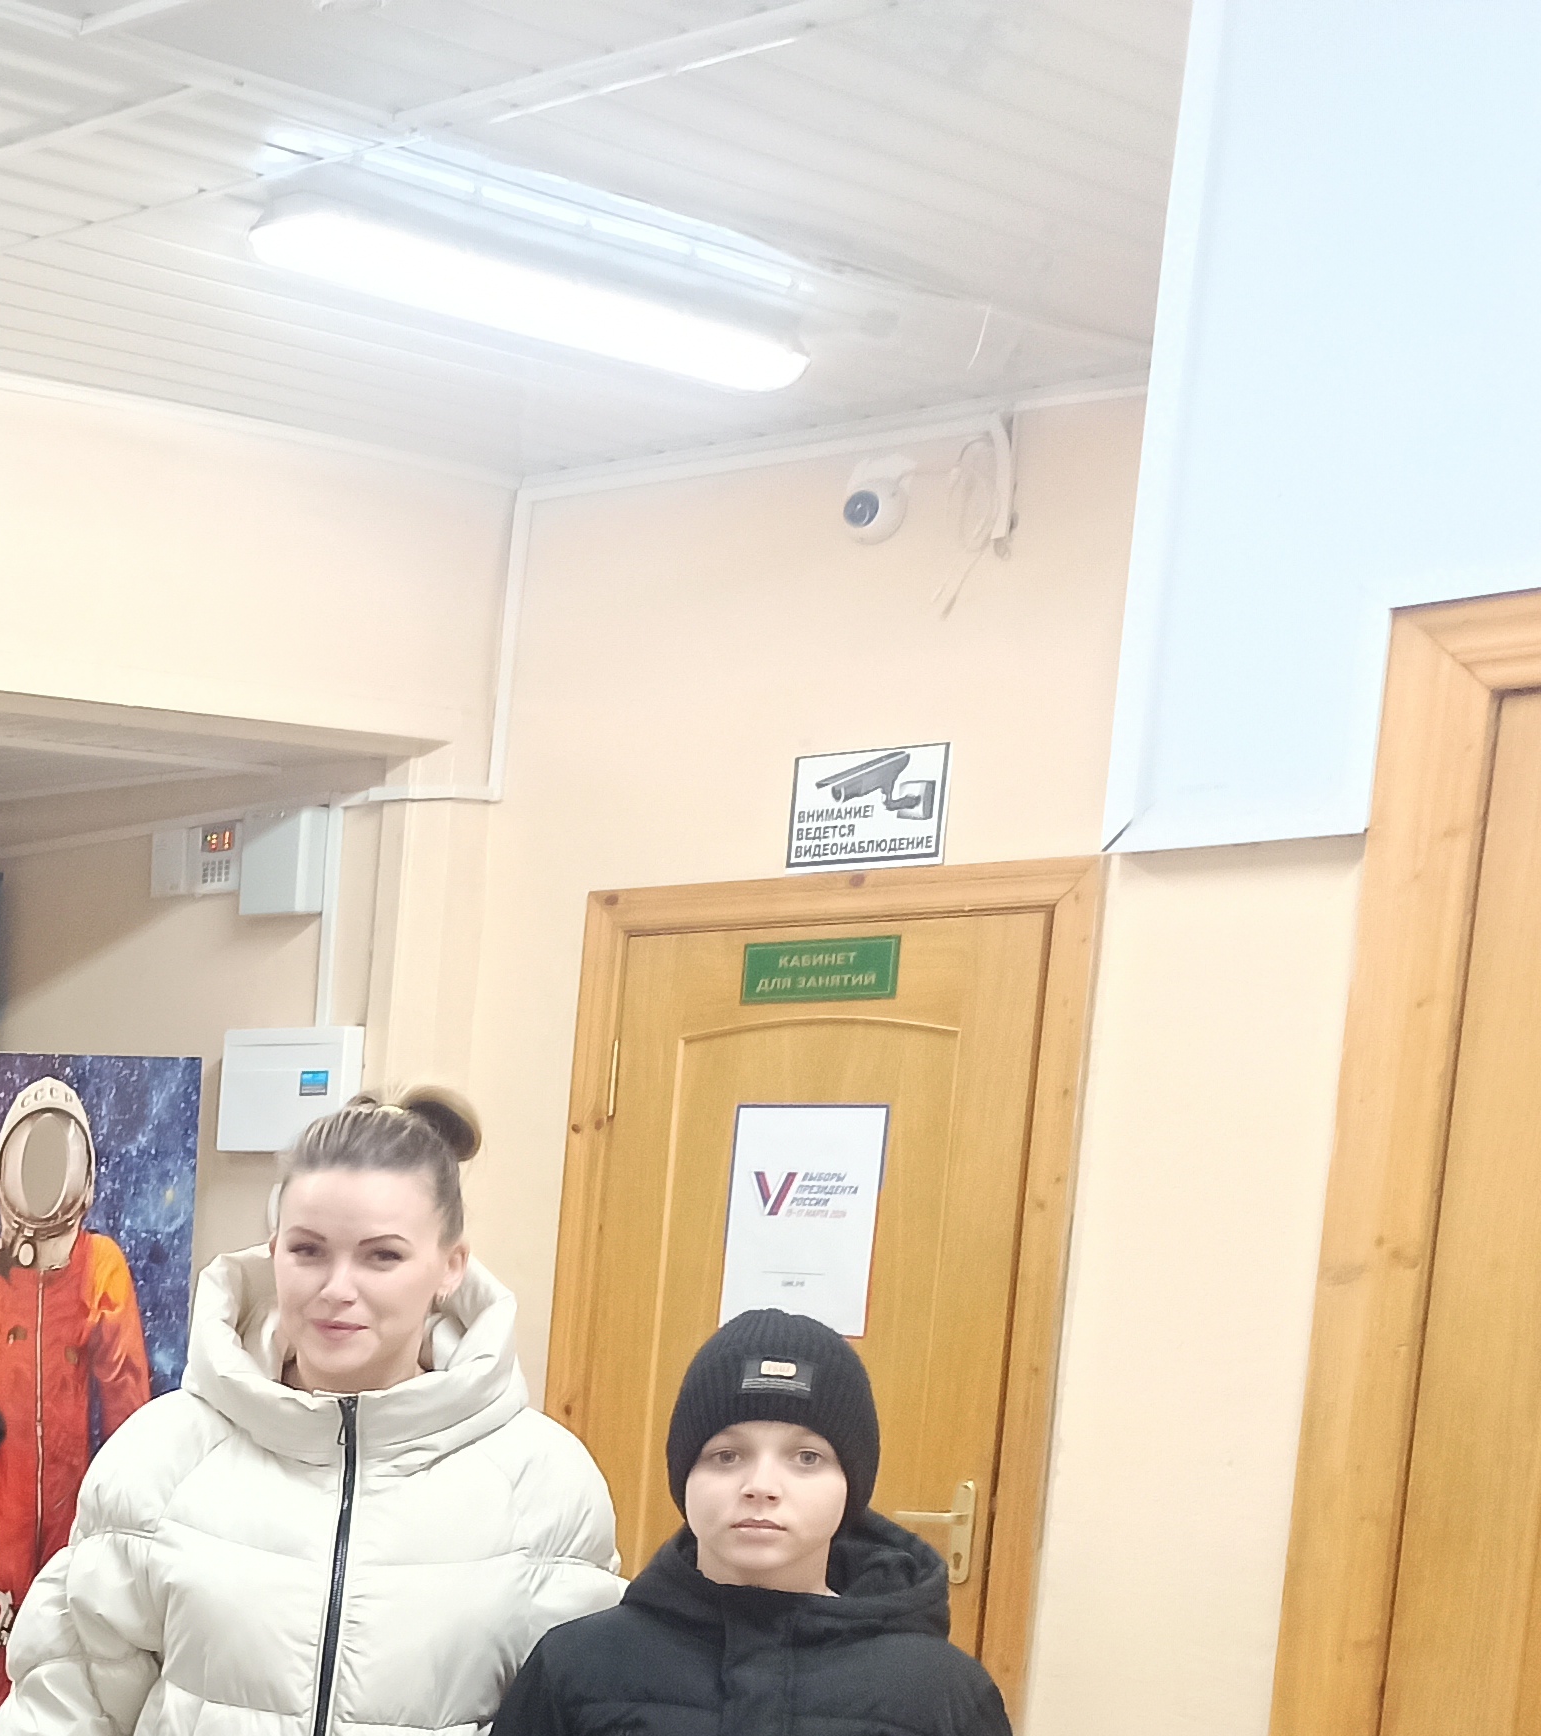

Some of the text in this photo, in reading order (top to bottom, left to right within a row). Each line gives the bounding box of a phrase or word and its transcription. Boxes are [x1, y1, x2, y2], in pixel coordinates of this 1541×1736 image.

[797, 804, 874, 825] ВНИМАНИЕ!
[796, 824, 856, 842] ВЕДЕТСЯ
[794, 836, 932, 859] ВИДЕОНАБЛЮДЕНИЕ
[778, 952, 857, 968] КАБИНЕТ
[755, 970, 877, 994] ДЛЯ ЗАНЯТИЙ
